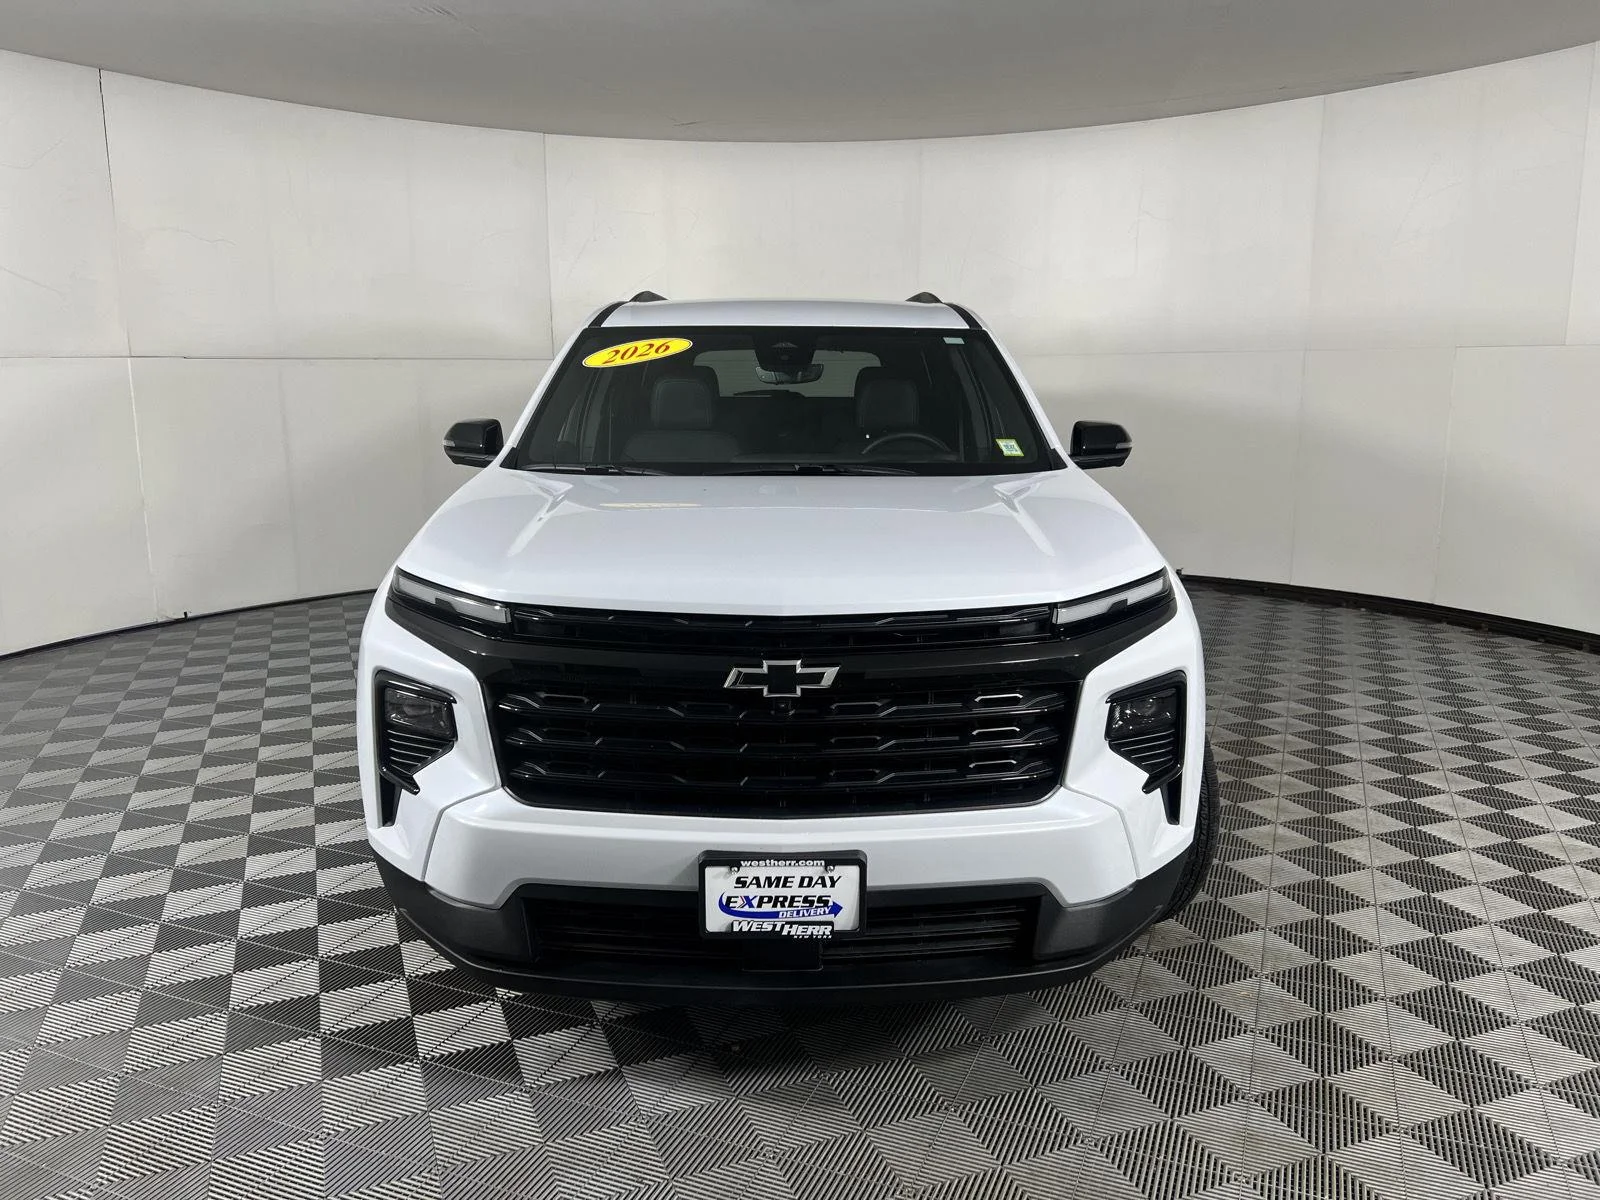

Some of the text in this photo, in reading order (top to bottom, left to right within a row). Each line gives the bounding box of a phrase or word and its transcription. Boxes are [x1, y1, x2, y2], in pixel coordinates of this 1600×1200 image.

[603, 341, 674, 365] 2026
[740, 859, 825, 867] westherr.com
[734, 876, 842, 889] SAME DAY
[725, 895, 831, 908] EXPRESS
[778, 906, 831, 919] DELIVERY
[732, 921, 833, 936] WEST HERR
